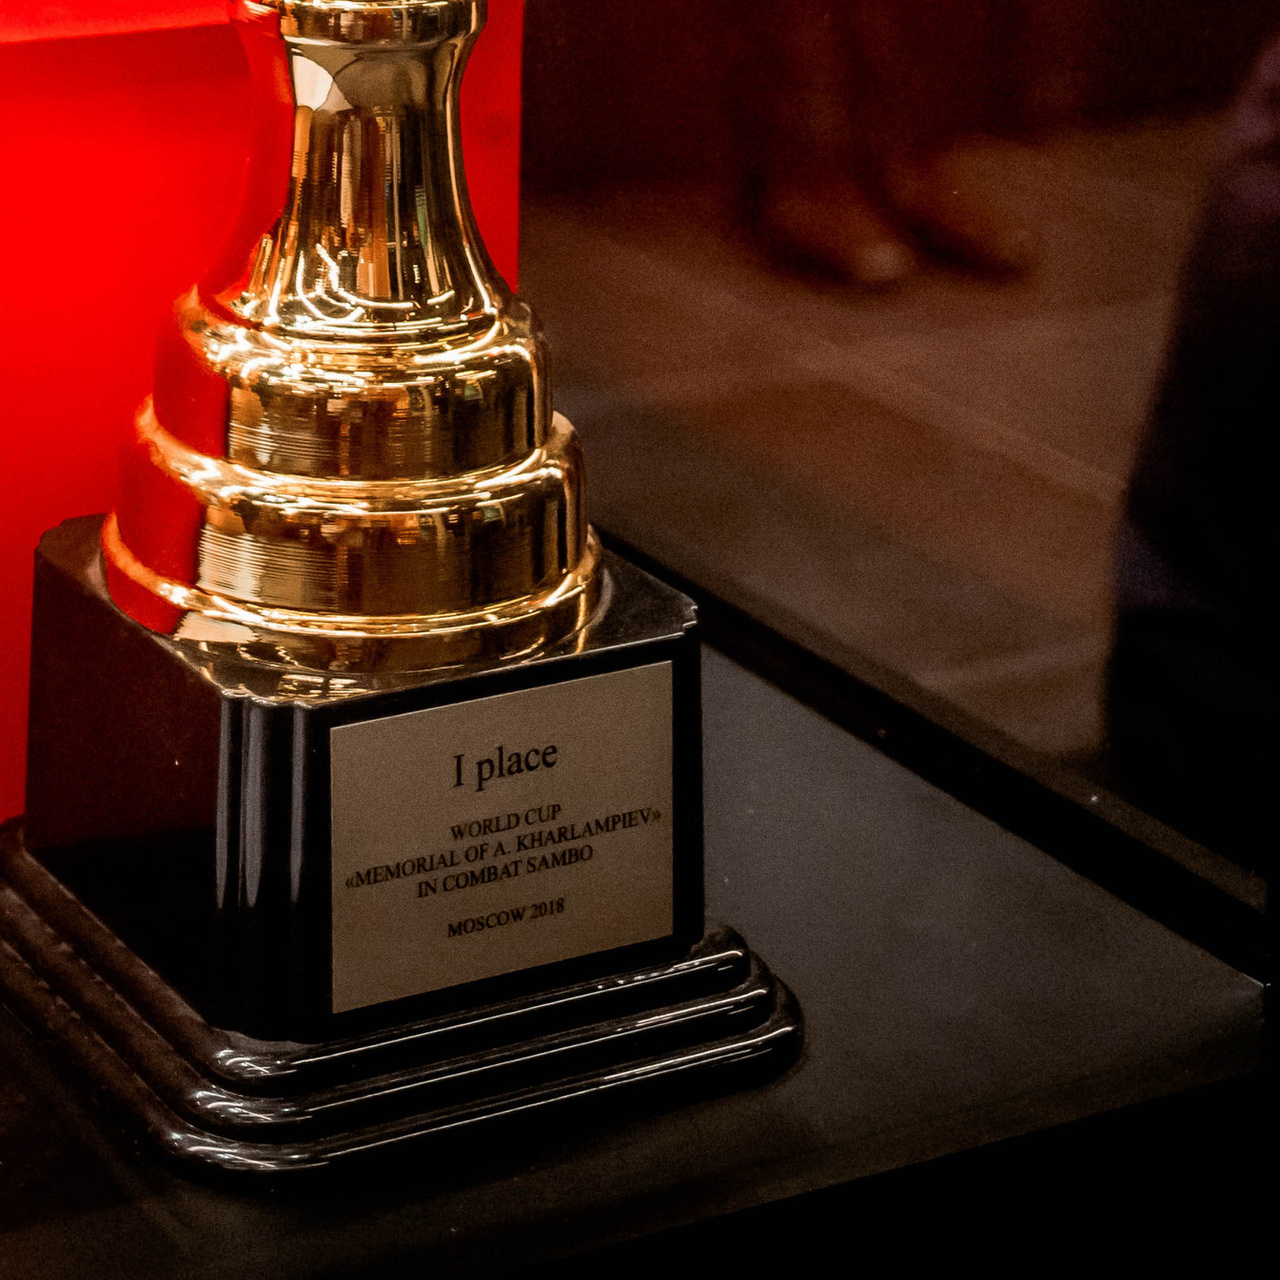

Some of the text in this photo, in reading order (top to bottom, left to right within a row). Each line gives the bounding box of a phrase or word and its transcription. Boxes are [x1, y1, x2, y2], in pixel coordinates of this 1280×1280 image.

[453, 744, 558, 791] I place
[450, 804, 562, 841] WORLD CUP
[345, 807, 662, 890] «MEMORIAL OF A. KHARLAMPIEV»
[416, 845, 594, 899] IN COMBAT SAMBO
[447, 897, 565, 939] MOSCOW 2018
